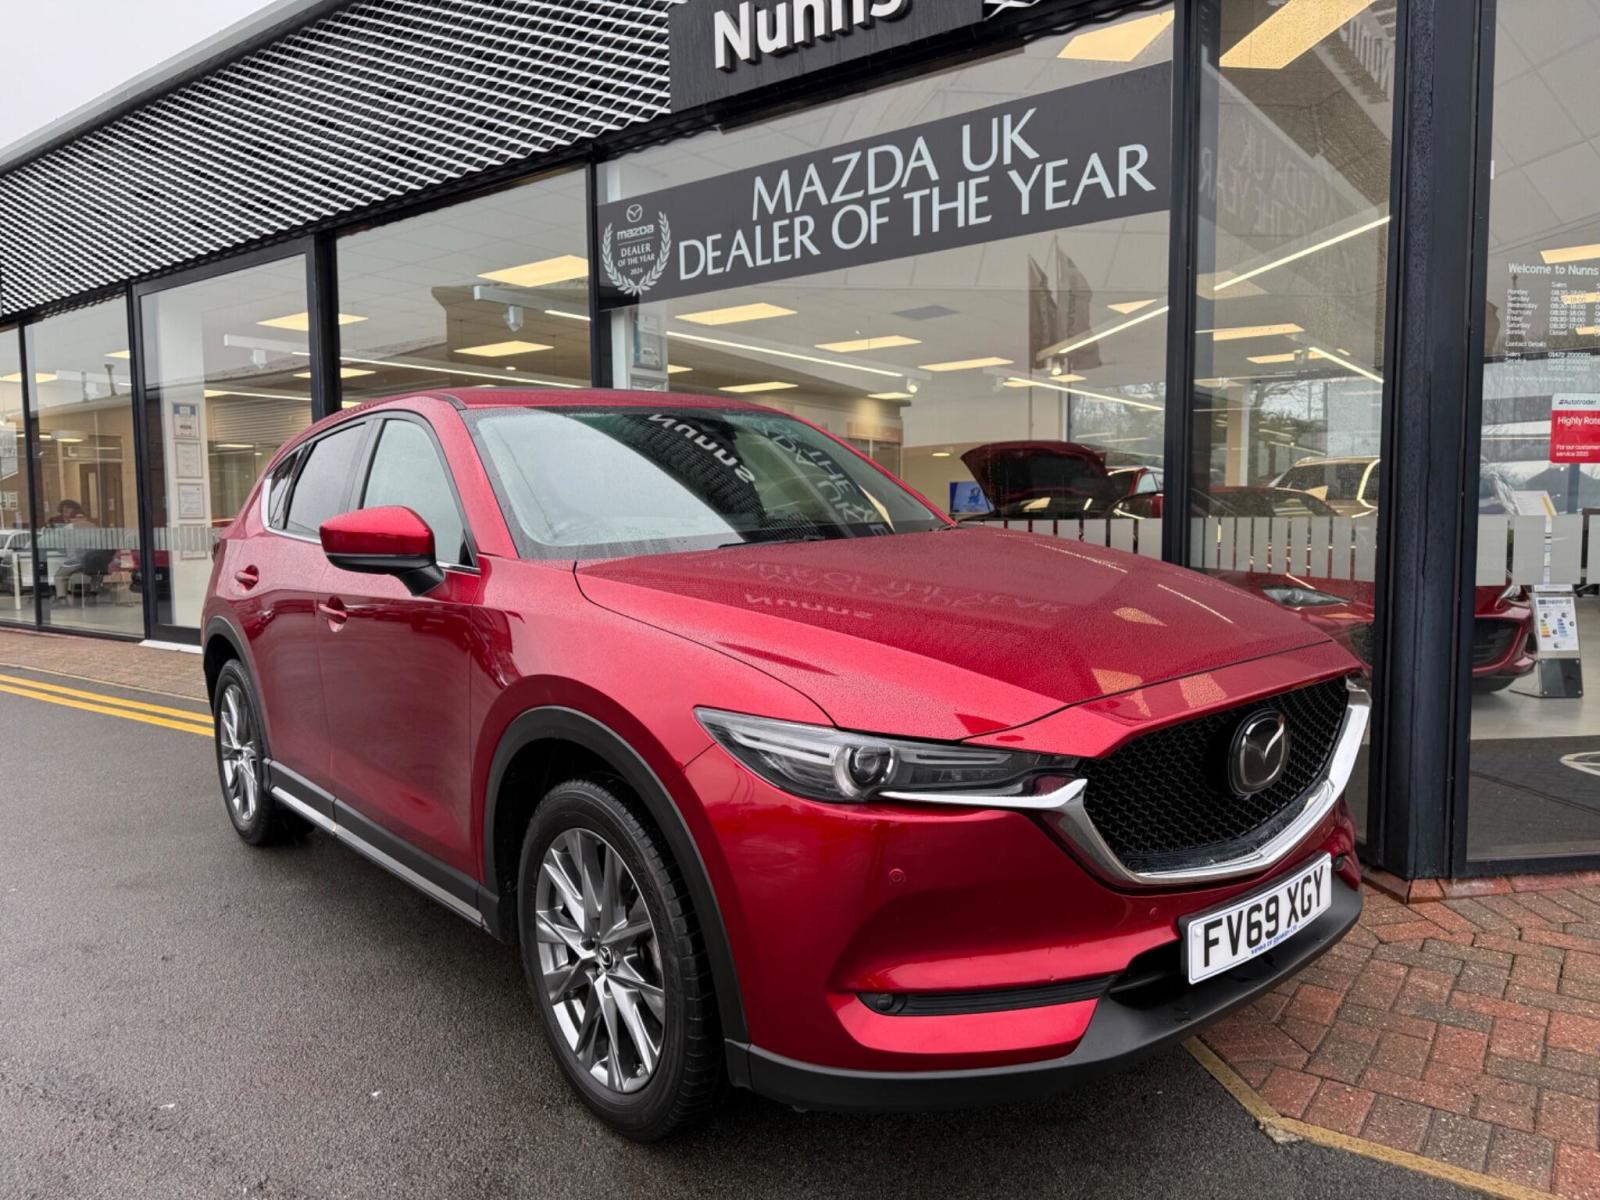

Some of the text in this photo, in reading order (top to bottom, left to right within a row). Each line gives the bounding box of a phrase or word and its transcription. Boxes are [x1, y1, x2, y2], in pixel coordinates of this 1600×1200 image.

[752, 107, 1040, 221] MAZDA UK
[678, 215, 822, 281] DEALER
[832, 197, 891, 251] OF
[903, 176, 993, 237] THE
[1007, 143, 1157, 216] YEAR
[620, 243, 652, 258] DEALER
[617, 253, 656, 268] OF THE YEAR
[1507, 263, 1599, 276] Welcome to Nunns
[1557, 416, 1583, 427] Highly
[1204, 865, 1324, 968] FV69 XGY
